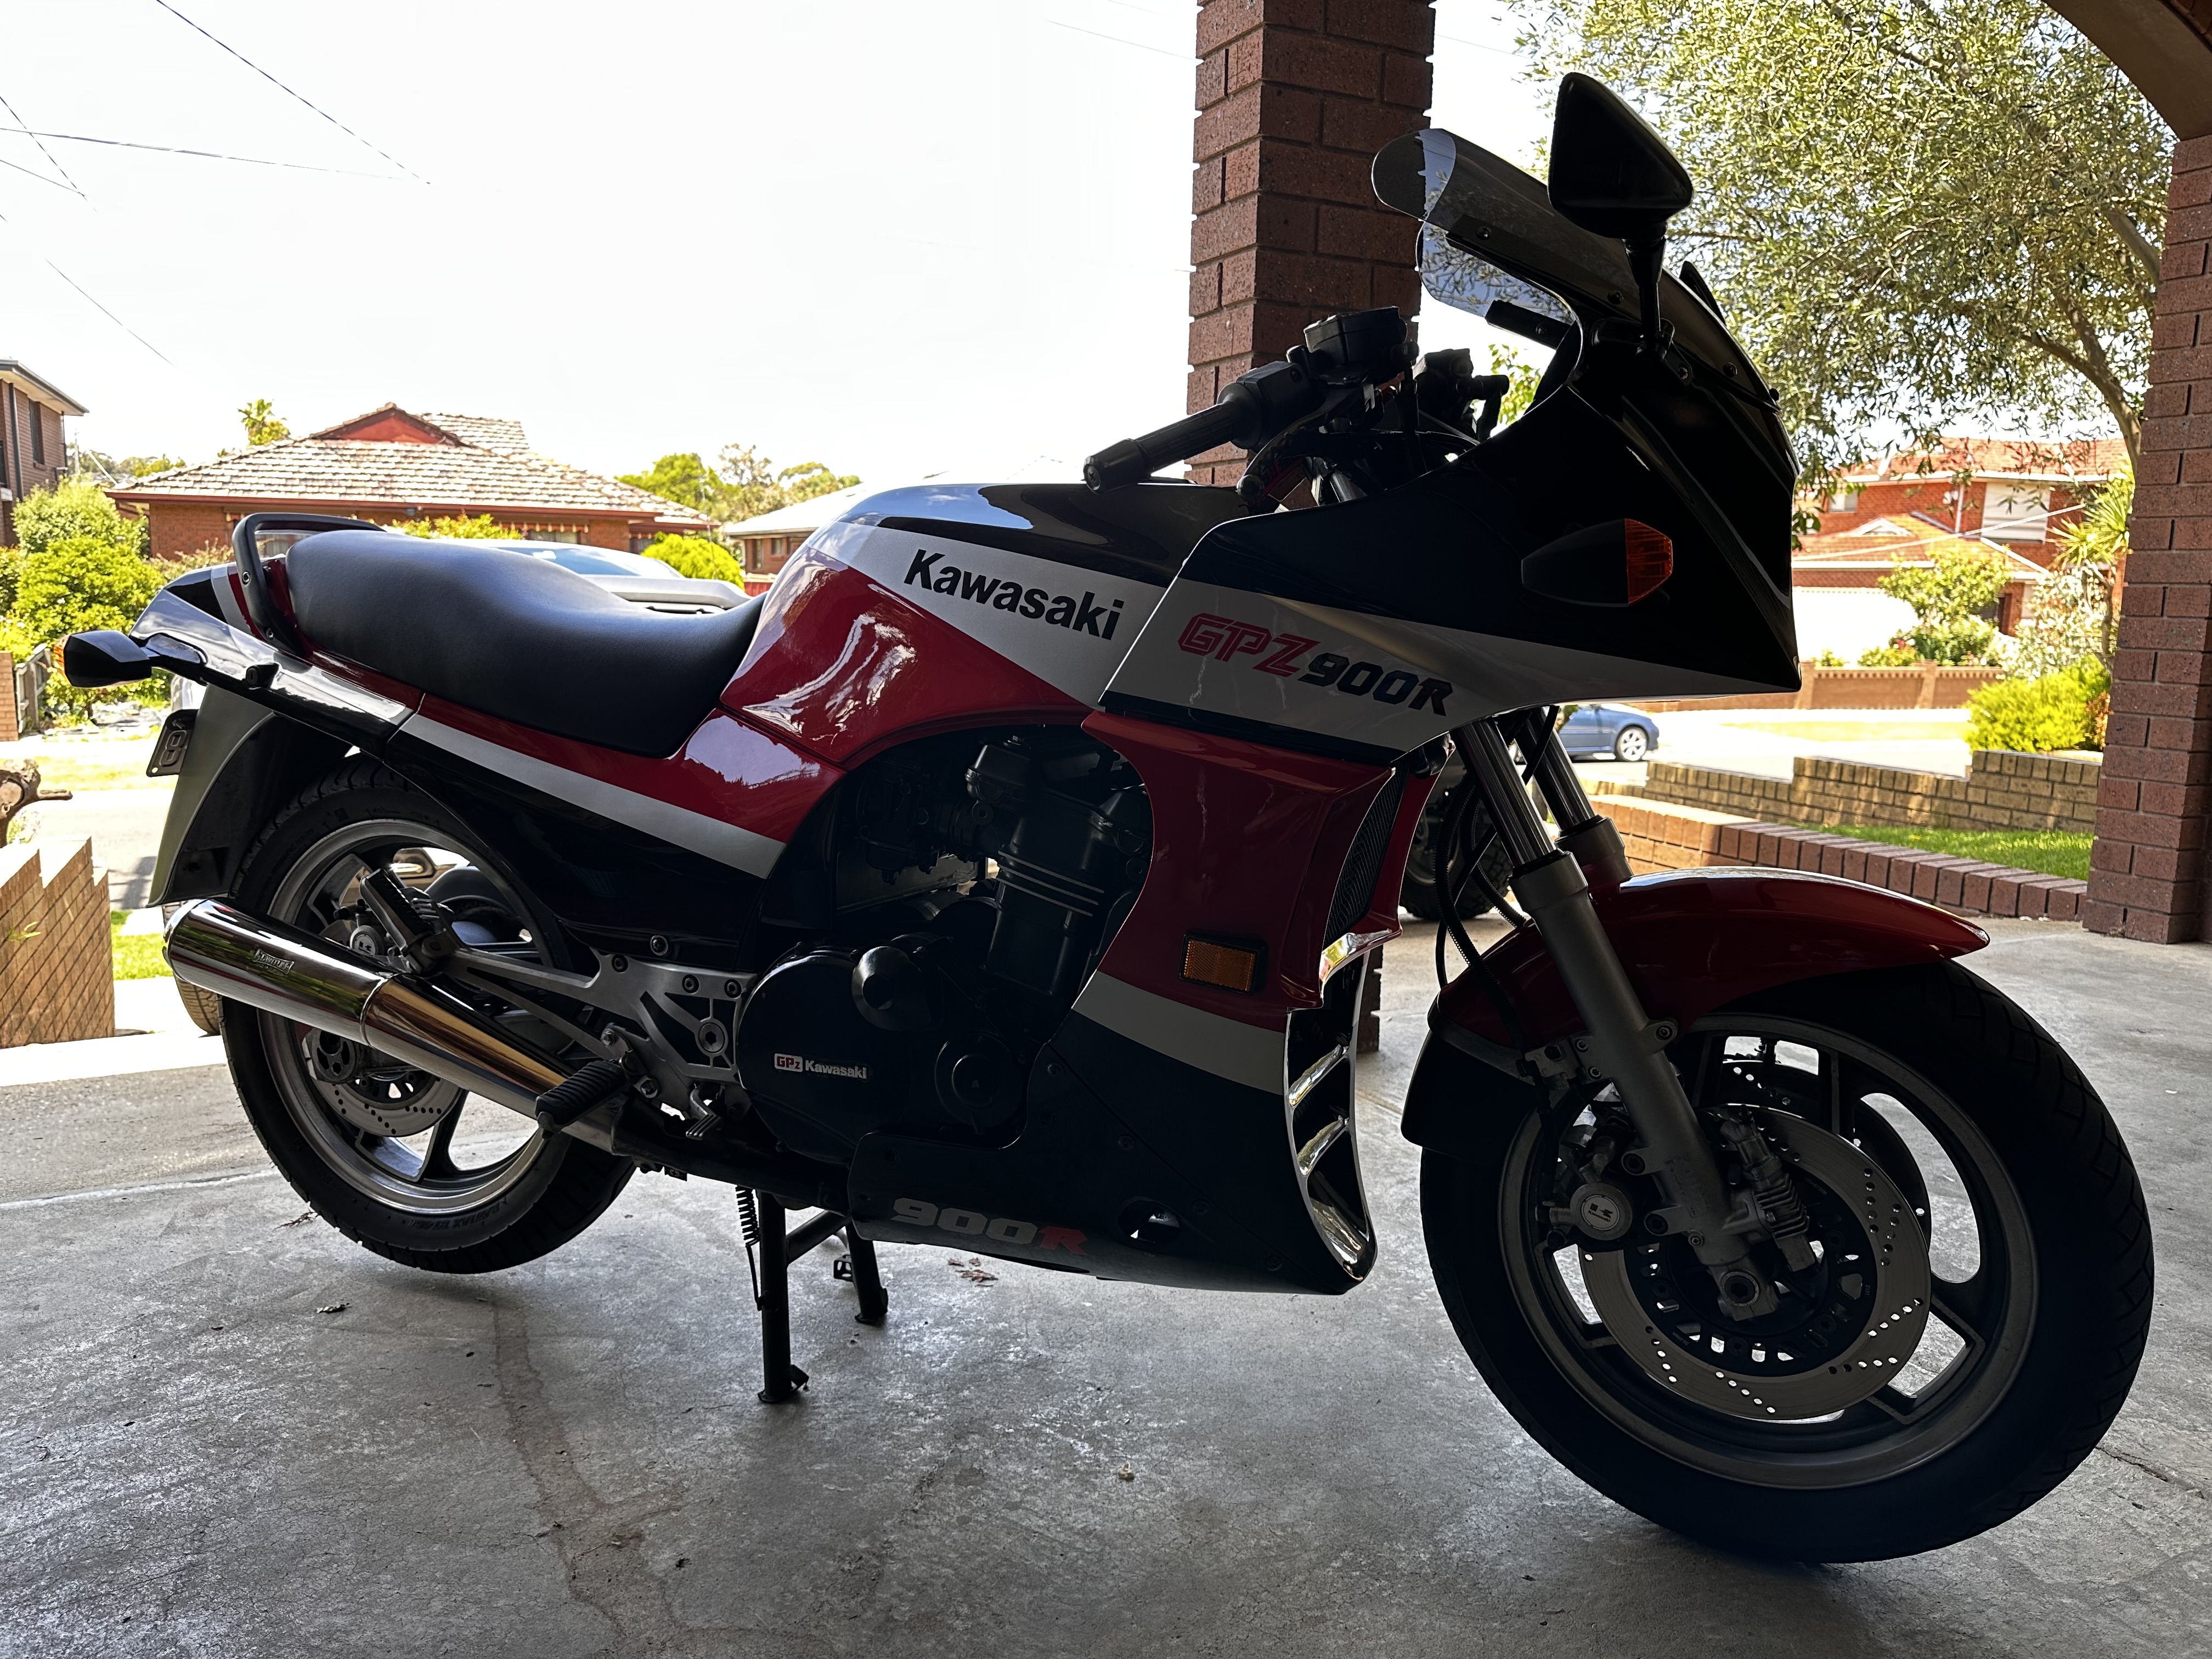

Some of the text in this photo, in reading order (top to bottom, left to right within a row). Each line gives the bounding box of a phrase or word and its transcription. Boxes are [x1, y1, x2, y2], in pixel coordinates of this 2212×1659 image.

[904, 549, 1124, 640] Kawasaki
[805, 1059, 868, 1080] Kawasaki
[889, 1197, 1088, 1255] 900R
